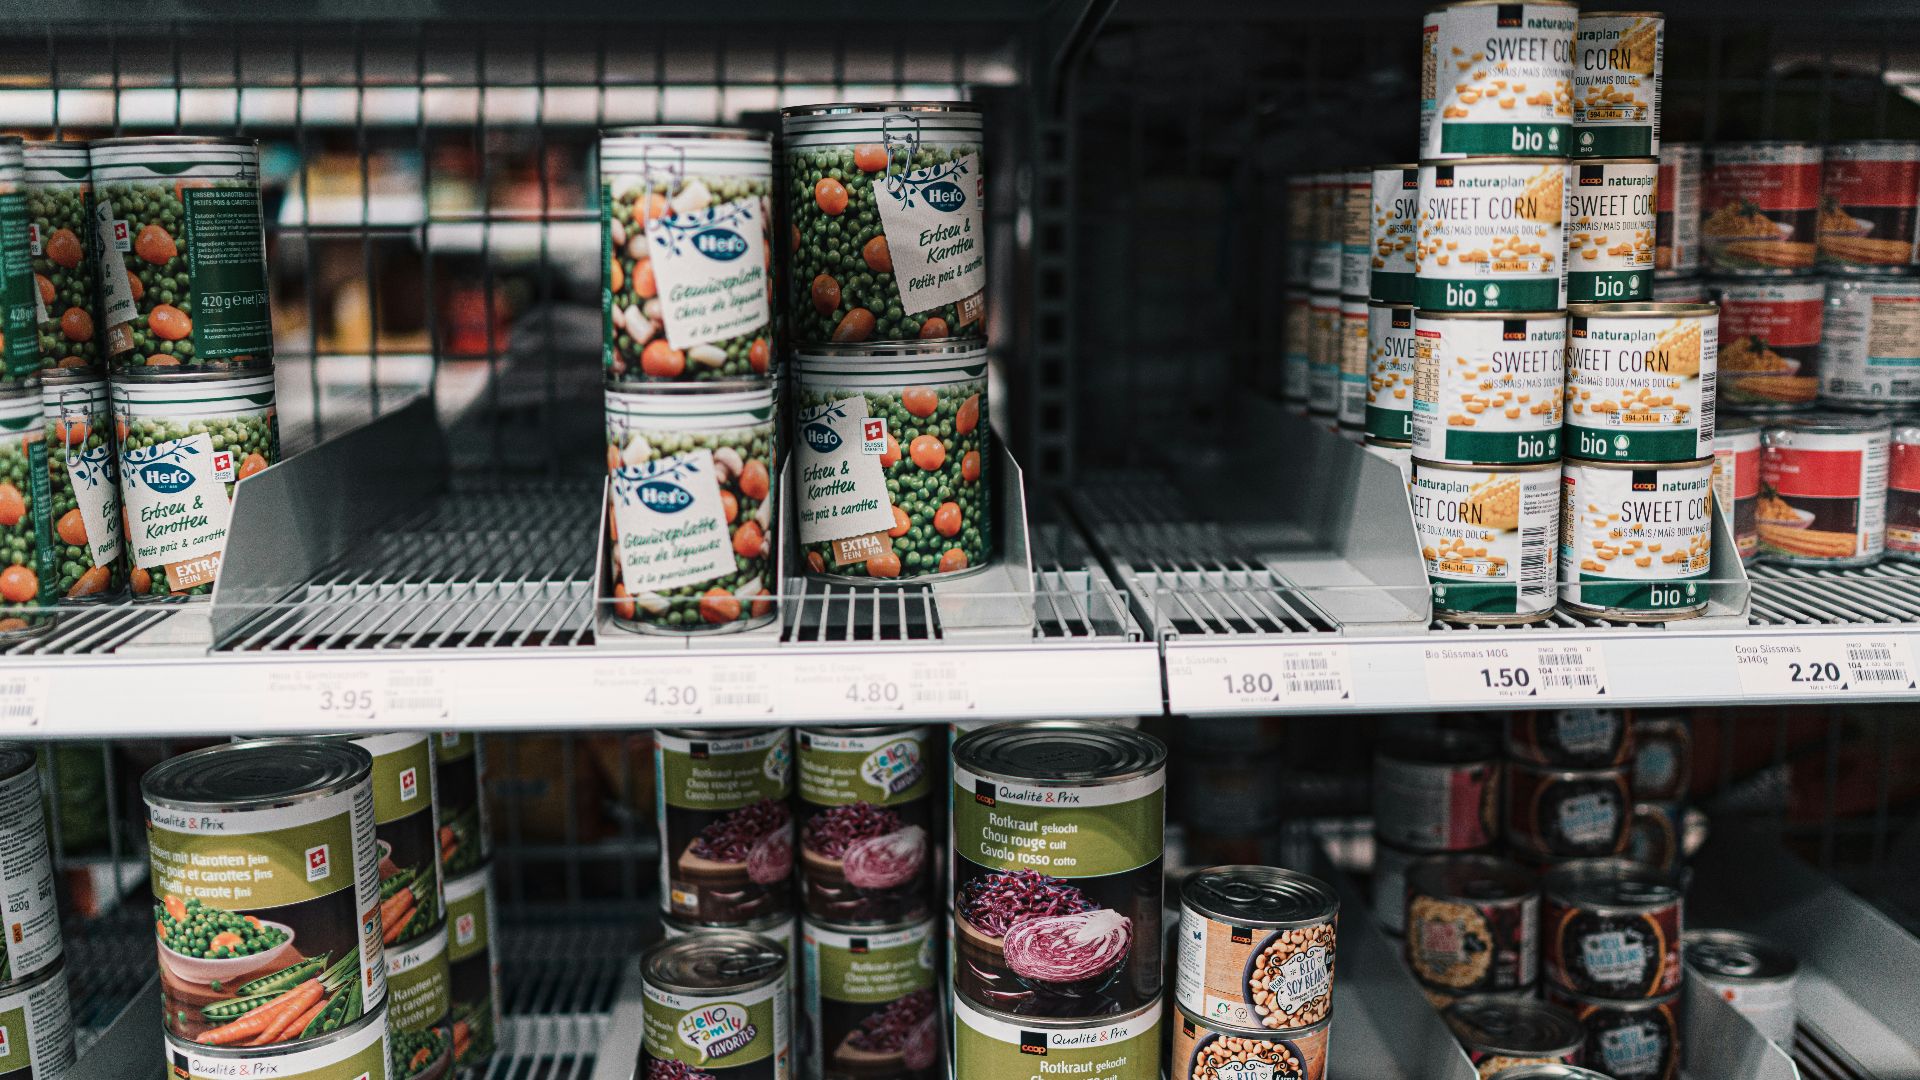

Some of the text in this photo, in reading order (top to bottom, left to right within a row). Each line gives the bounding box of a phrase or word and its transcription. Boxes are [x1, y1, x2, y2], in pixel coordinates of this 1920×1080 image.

[1486, 37, 1548, 62] SWEET
[1585, 48, 1631, 70] CORN
[1511, 126, 1543, 150] bio
[1437, 178, 1454, 187] coop
[1459, 176, 1525, 190] naturaplan
[929, 188, 963, 204] Hero
[1570, 195, 1628, 216] SWEET
[1429, 197, 1480, 220] SWEET
[1489, 197, 1537, 220] CORN
[920, 217, 972, 247] Erbsen &
[699, 235, 745, 252] Hero
[926, 237, 974, 264] Karotten
[909, 264, 963, 292] Petits pois &
[1595, 276, 1623, 297] bio
[202, 296, 254, 309] 420 g net
[1447, 282, 1477, 307] bio
[711, 300, 725, 313] de
[1591, 329, 1656, 343] naturaplan
[1385, 337, 1415, 358] SWE
[1492, 351, 1549, 373] SWEET
[1567, 346, 1669, 372] SWEET CORN
[1653, 378, 1676, 388] DOLCE
[808, 429, 838, 445] Hero
[1518, 435, 1544, 458] bio
[1581, 432, 1607, 456] bio
[146, 470, 190, 484] Hero
[804, 461, 850, 482] Erbsen &
[642, 487, 690, 505] Hero
[808, 480, 856, 501] Karotten
[1418, 478, 1469, 494] naturaplan
[1633, 483, 1656, 491] coop
[141, 495, 204, 522] Erbsen &
[815, 498, 879, 524] pois & carottes
[1437, 500, 1483, 525] CORN
[1621, 501, 1682, 523] SWEET
[146, 513, 209, 539] Karotten
[624, 516, 719, 549] Gemüseplatte
[1465, 529, 1489, 540] DOLCE
[138, 537, 189, 558] Petits pois &
[841, 534, 881, 553] EXTRA
[843, 546, 883, 561] FEIN FIN
[175, 556, 221, 577] EXTRA
[627, 551, 651, 567] Choix
[654, 550, 668, 562] de
[179, 573, 201, 586] FEIN
[1651, 585, 1681, 606] bio
[1425, 649, 1509, 659] Bio Süssmais 140G
[1760, 643, 1801, 654] Süssmais
[1186, 655, 1227, 665] Süssmais
[1737, 655, 1768, 665] 3x140g
[1481, 667, 1530, 688] 1.50
[1789, 661, 1841, 682] 2.20
[846, 682, 898, 703] 4.80
[1223, 673, 1273, 694] 1.80
[320, 690, 373, 711] 3.95
[644, 685, 697, 706] 4.30
[867, 743, 908, 772] Hello
[872, 752, 918, 783] Family
[976, 793, 995, 806] coop
[1000, 786, 1080, 804] Qualité & Prix
[152, 810, 225, 831] Qualité & Prix
[989, 812, 1078, 835] Rotkraut gekocht
[982, 826, 1066, 851] Chou rouge cuit
[172, 852, 269, 867] mit Karotten fein
[980, 842, 1077, 866] Cavolo rosso cotto
[167, 866, 273, 883] pois et carottes fins
[160, 876, 252, 900] Piselli e carote fini
[9, 900, 30, 914] 420g
[1232, 935, 1251, 944] coop
[1300, 958, 1315, 976] BIO
[394, 978, 432, 1003] Karotten
[1270, 976, 1285, 990] VEGAN
[1286, 978, 1303, 997] SOY
[1304, 964, 1326, 990] BEANS
[660, 993, 680, 1006] & Prix
[390, 1004, 401, 1017] et
[396, 1009, 426, 1029] carote
[682, 1008, 727, 1032] Hello
[687, 1016, 742, 1045] Family
[709, 1025, 756, 1057] FAVORITES
[1052, 1027, 1128, 1046] Qualité & Prix
[1184, 1028, 1195, 1037] coop
[1022, 1044, 1047, 1055] coop
[174, 1065, 189, 1079] coop
[192, 1058, 278, 1077] Qualité & Prix
[1040, 1056, 1127, 1074] Rotkraut gekocht
